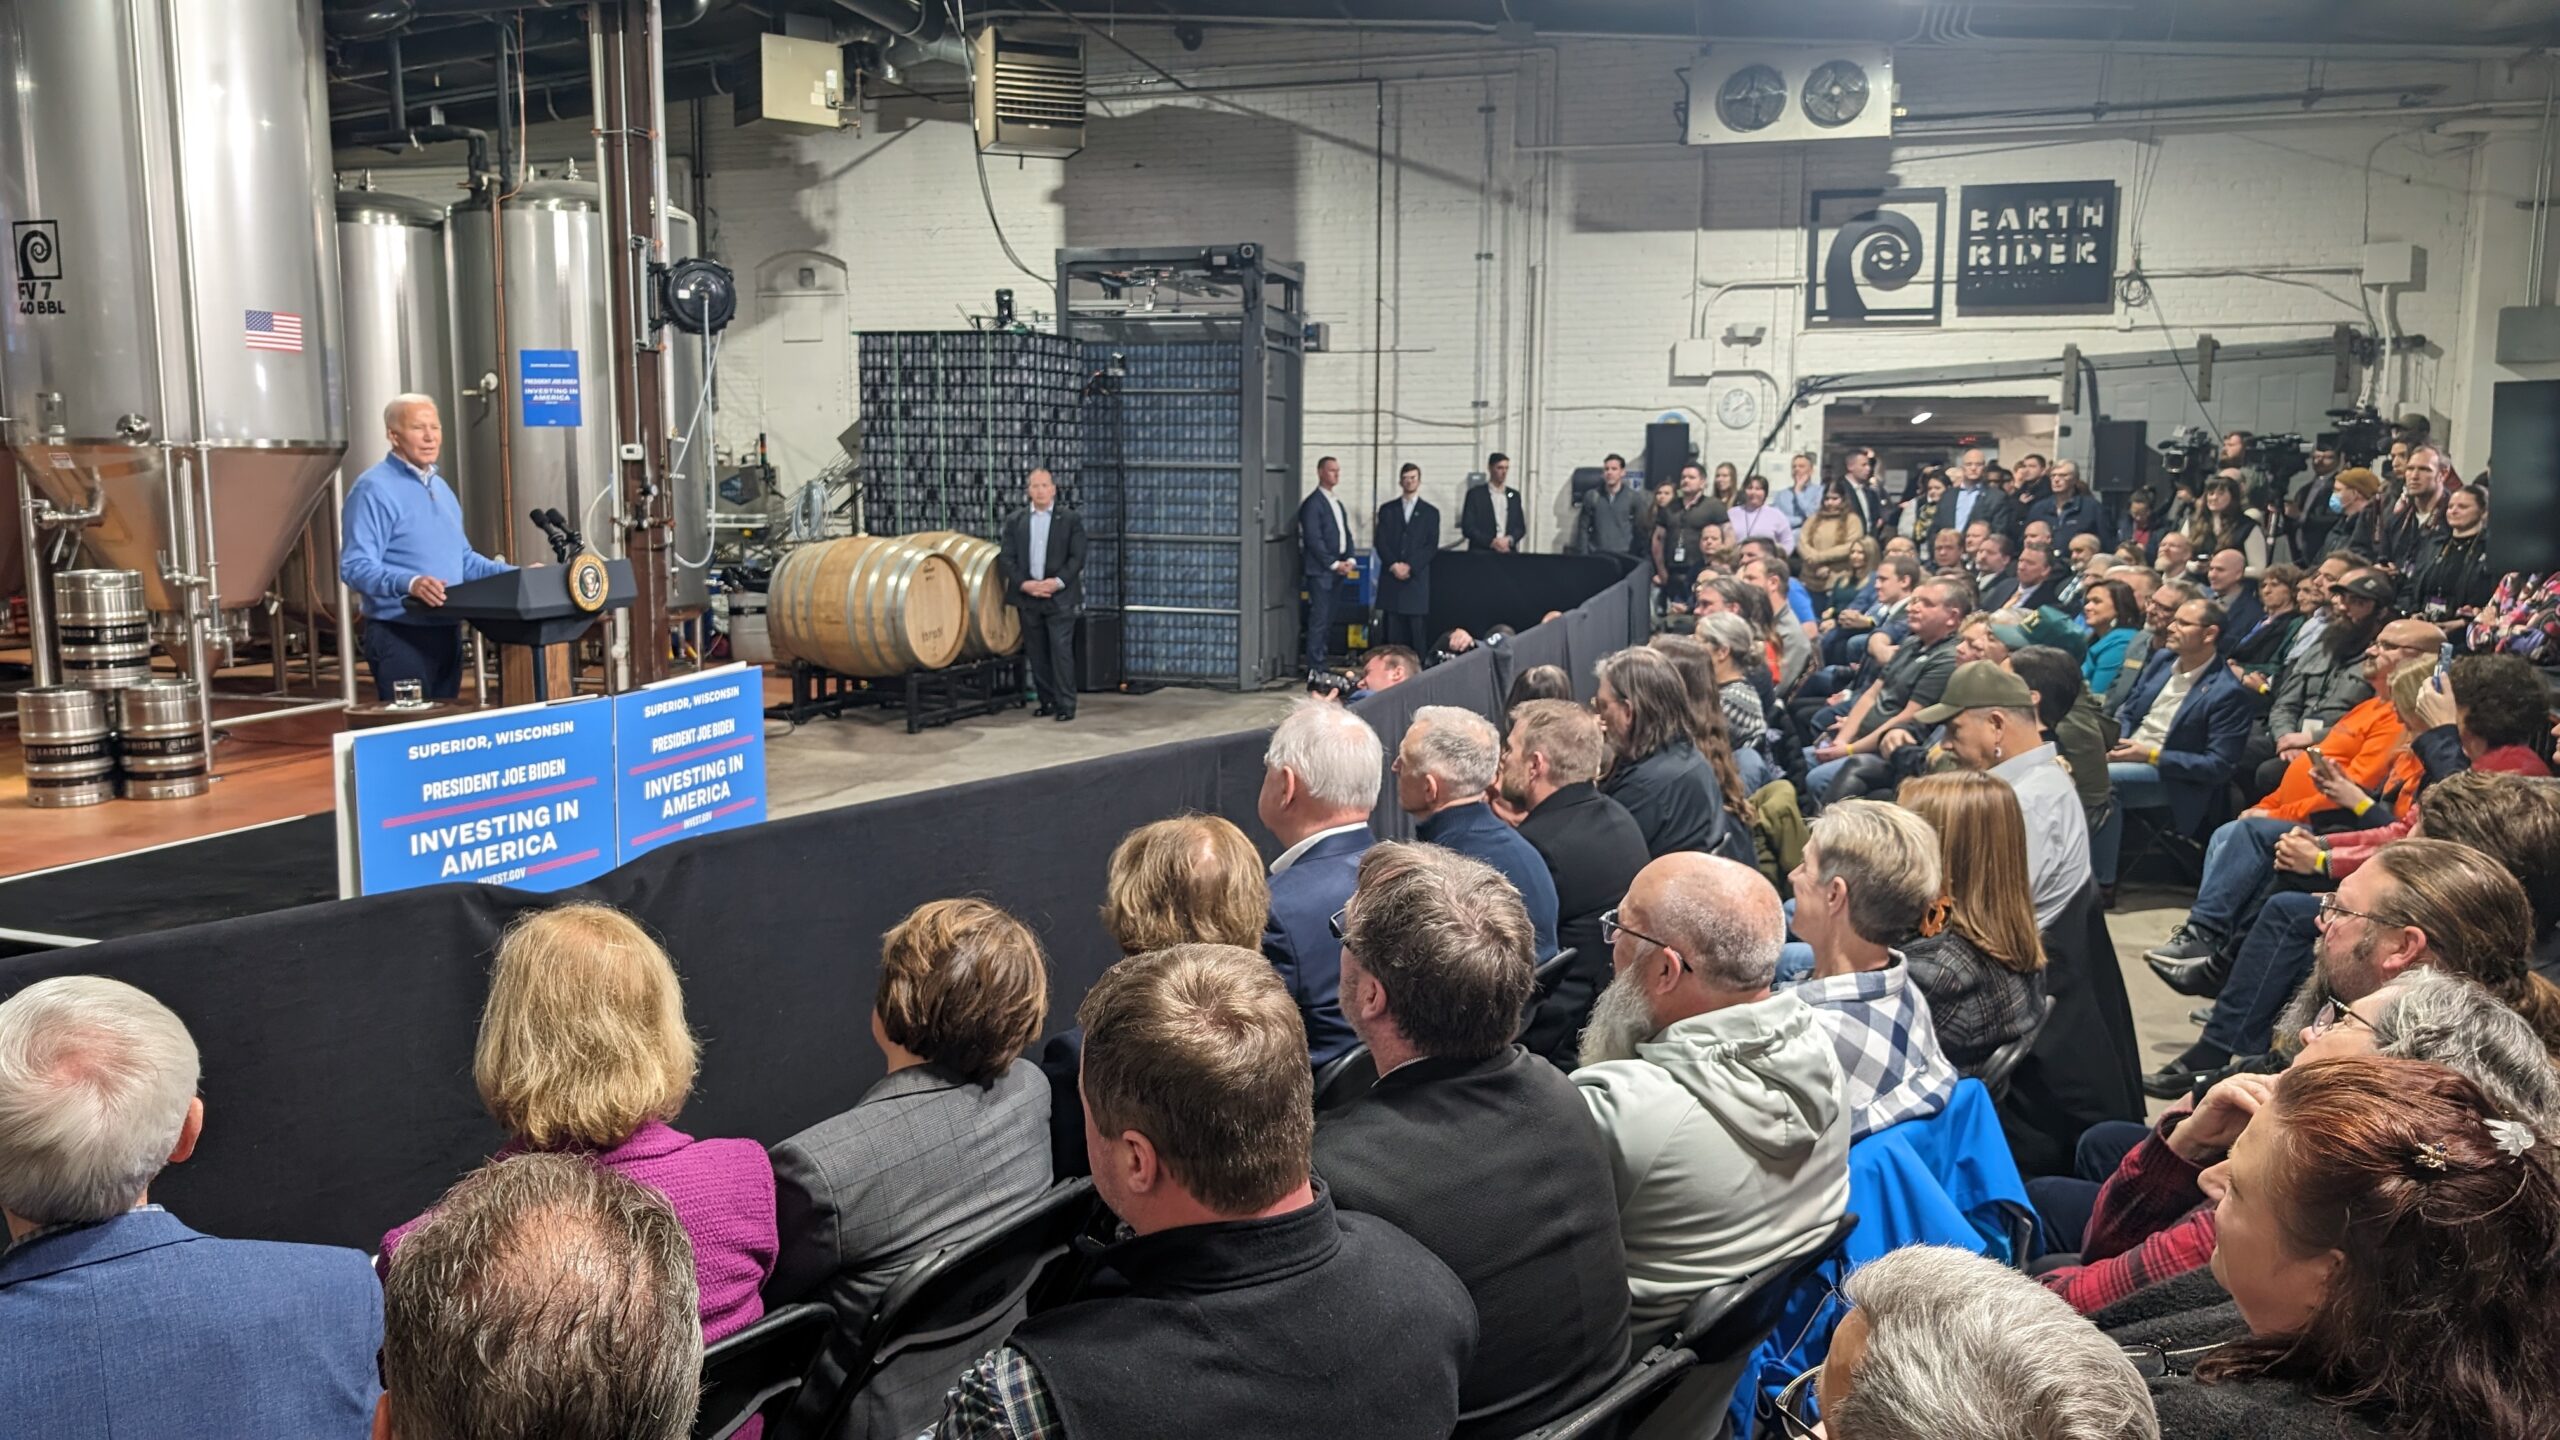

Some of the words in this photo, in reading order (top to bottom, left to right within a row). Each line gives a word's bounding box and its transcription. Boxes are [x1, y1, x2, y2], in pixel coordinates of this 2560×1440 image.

[1970, 205, 2103, 231] EARTH
[1968, 242, 2097, 266] RIDER
[17, 281, 36, 300] FV
[41, 281, 52, 300] 7
[20, 300, 35, 315] 40
[37, 300, 66, 315] BBL
[644, 698, 692, 718] SUPERIOR,
[693, 686, 739, 706] WISCONSIN
[408, 735, 493, 761] SUPERIOR,
[495, 720, 575, 746] WISCONSIN
[652, 728, 697, 754] PRESIDENT
[697, 724, 712, 742] JOE
[712, 718, 735, 737] BIDEN
[422, 771, 500, 802] PRESIDENT
[501, 765, 527, 787] JOE
[528, 757, 566, 782] BIDEN
[644, 761, 727, 800] INVESTING
[729, 754, 743, 773] IN
[662, 781, 731, 818] AMERICA
[410, 806, 550, 856] INVESTING
[555, 798, 579, 824] IN
[441, 831, 558, 877] AMERICA
